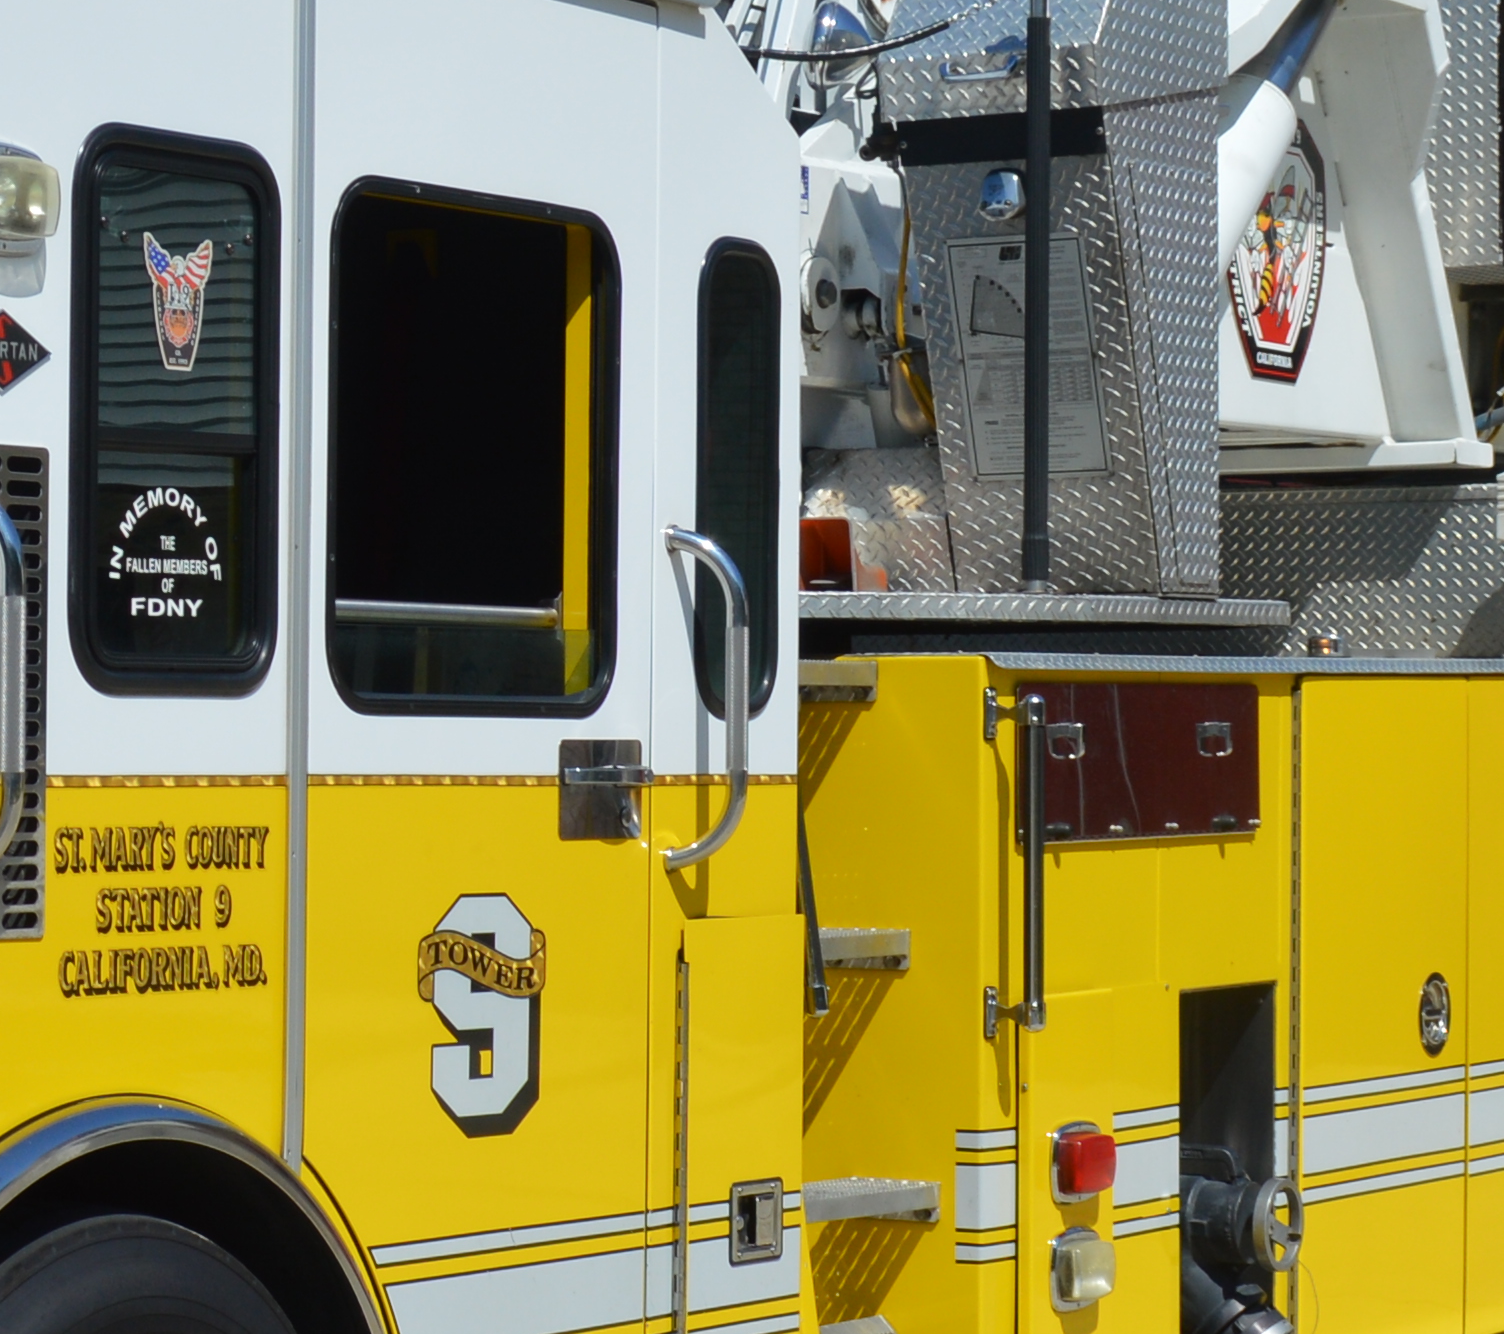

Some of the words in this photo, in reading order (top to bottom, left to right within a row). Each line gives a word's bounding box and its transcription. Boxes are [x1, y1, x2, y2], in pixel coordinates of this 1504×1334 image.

[1301, 191, 1324, 329] VOLUNTEERS
[108, 545, 125, 580] IN
[118, 486, 208, 539] MEMORY
[204, 536, 222, 582] OF
[159, 535, 176, 552] THE
[125, 557, 162, 574] FALLEN
[163, 558, 208, 575] MEMBERS
[161, 577, 175, 594] OF
[130, 596, 203, 618] FDNY
[53, 825, 87, 875] ST.
[89, 820, 176, 872] MARY'S
[184, 824, 270, 870] COUNTY
[95, 885, 202, 934] STATION
[214, 883, 232, 929] 9
[58, 946, 220, 999] CALIFORNIA,
[222, 943, 268, 989] MD.
[427, 939, 536, 991] TOWER
[430, 892, 541, 1139] 9
